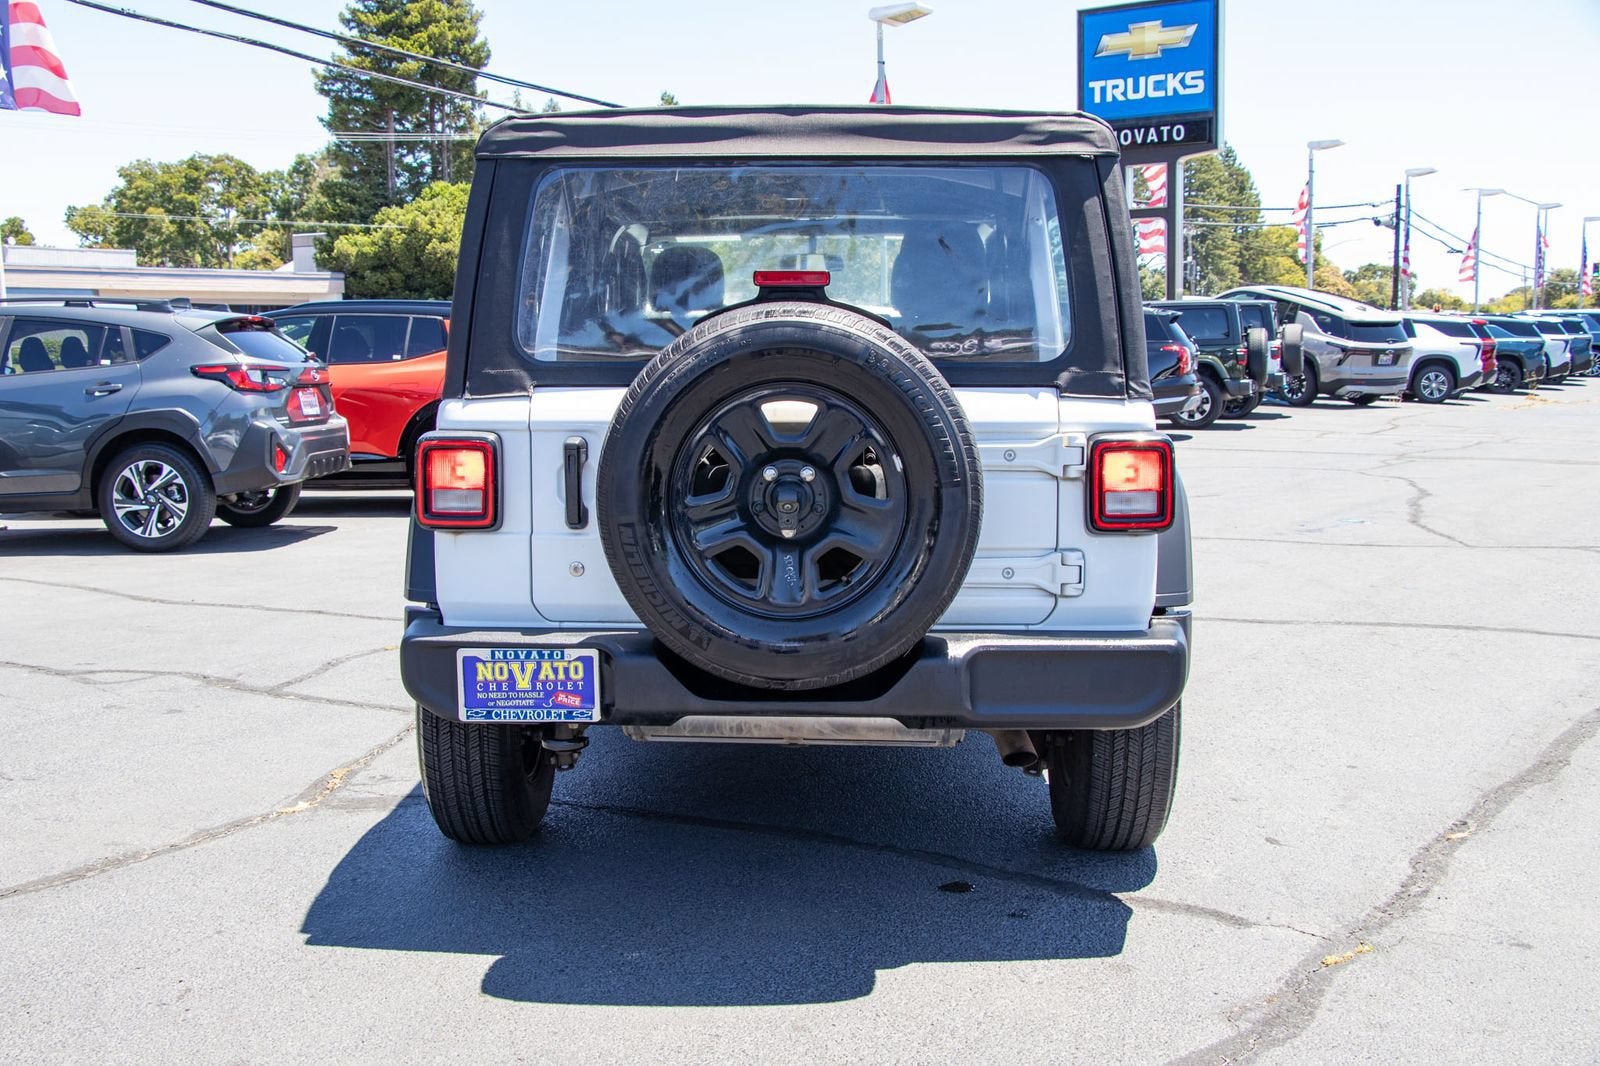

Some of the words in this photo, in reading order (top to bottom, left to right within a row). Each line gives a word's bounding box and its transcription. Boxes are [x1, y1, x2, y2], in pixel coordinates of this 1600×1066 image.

[1088, 70, 1205, 104] TRUCKS
[1113, 124, 1185, 145] OVATO
[618, 525, 690, 633] MICHELIN
[494, 650, 562, 660] NOVATO
[476, 661, 585, 690] NOVATO
[518, 691, 545, 699] HASSLE
[491, 709, 567, 720] CHEVROLET
